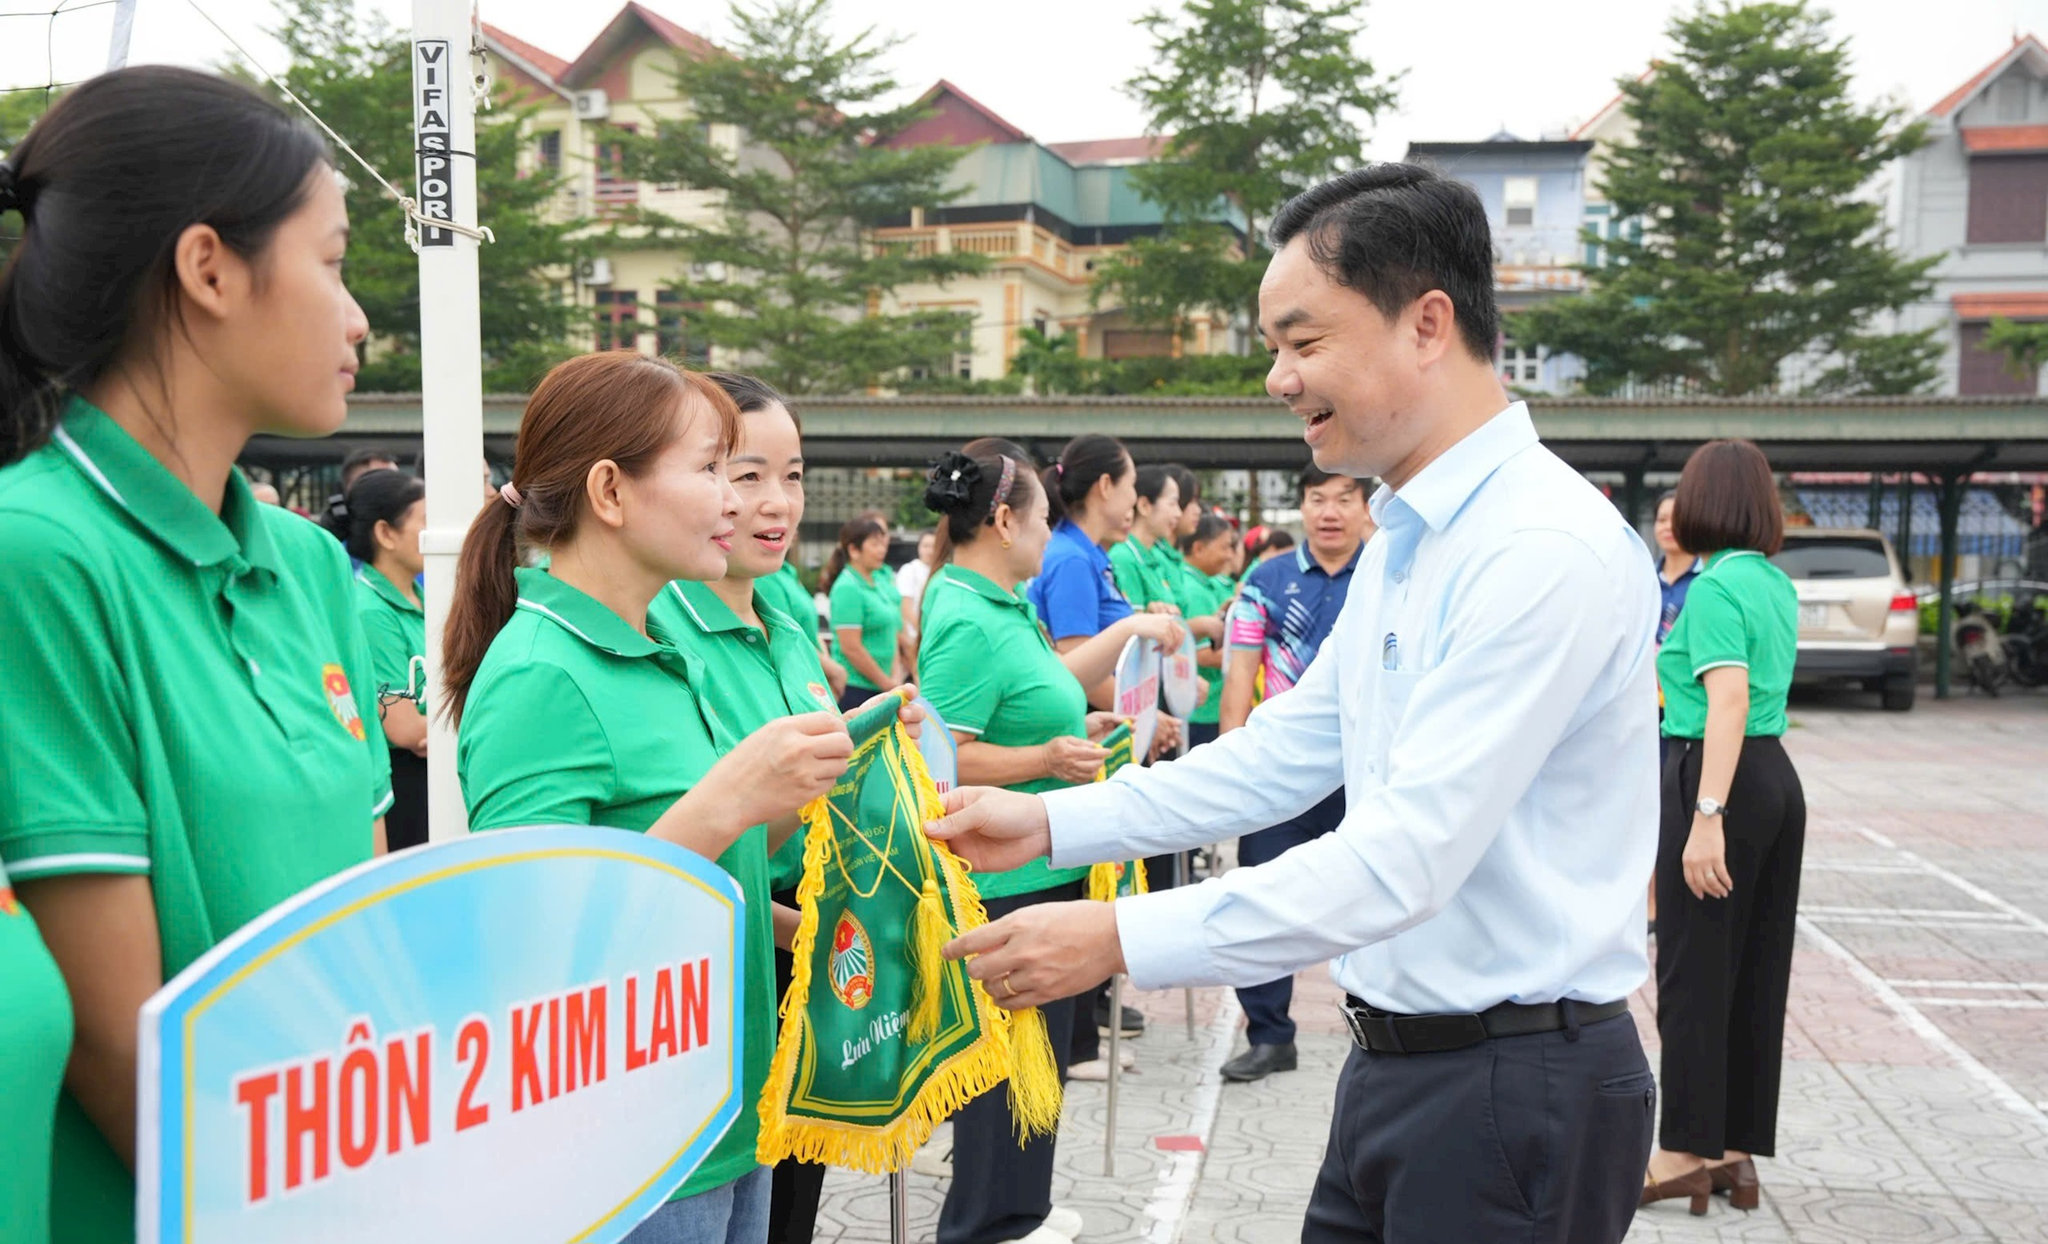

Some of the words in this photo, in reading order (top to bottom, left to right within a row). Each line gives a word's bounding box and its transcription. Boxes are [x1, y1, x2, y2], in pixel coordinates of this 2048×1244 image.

[236, 1021, 432, 1203] THÔN
[455, 1018, 490, 1133] 2
[511, 984, 607, 1113] KIM
[625, 957, 710, 1073] LAN
